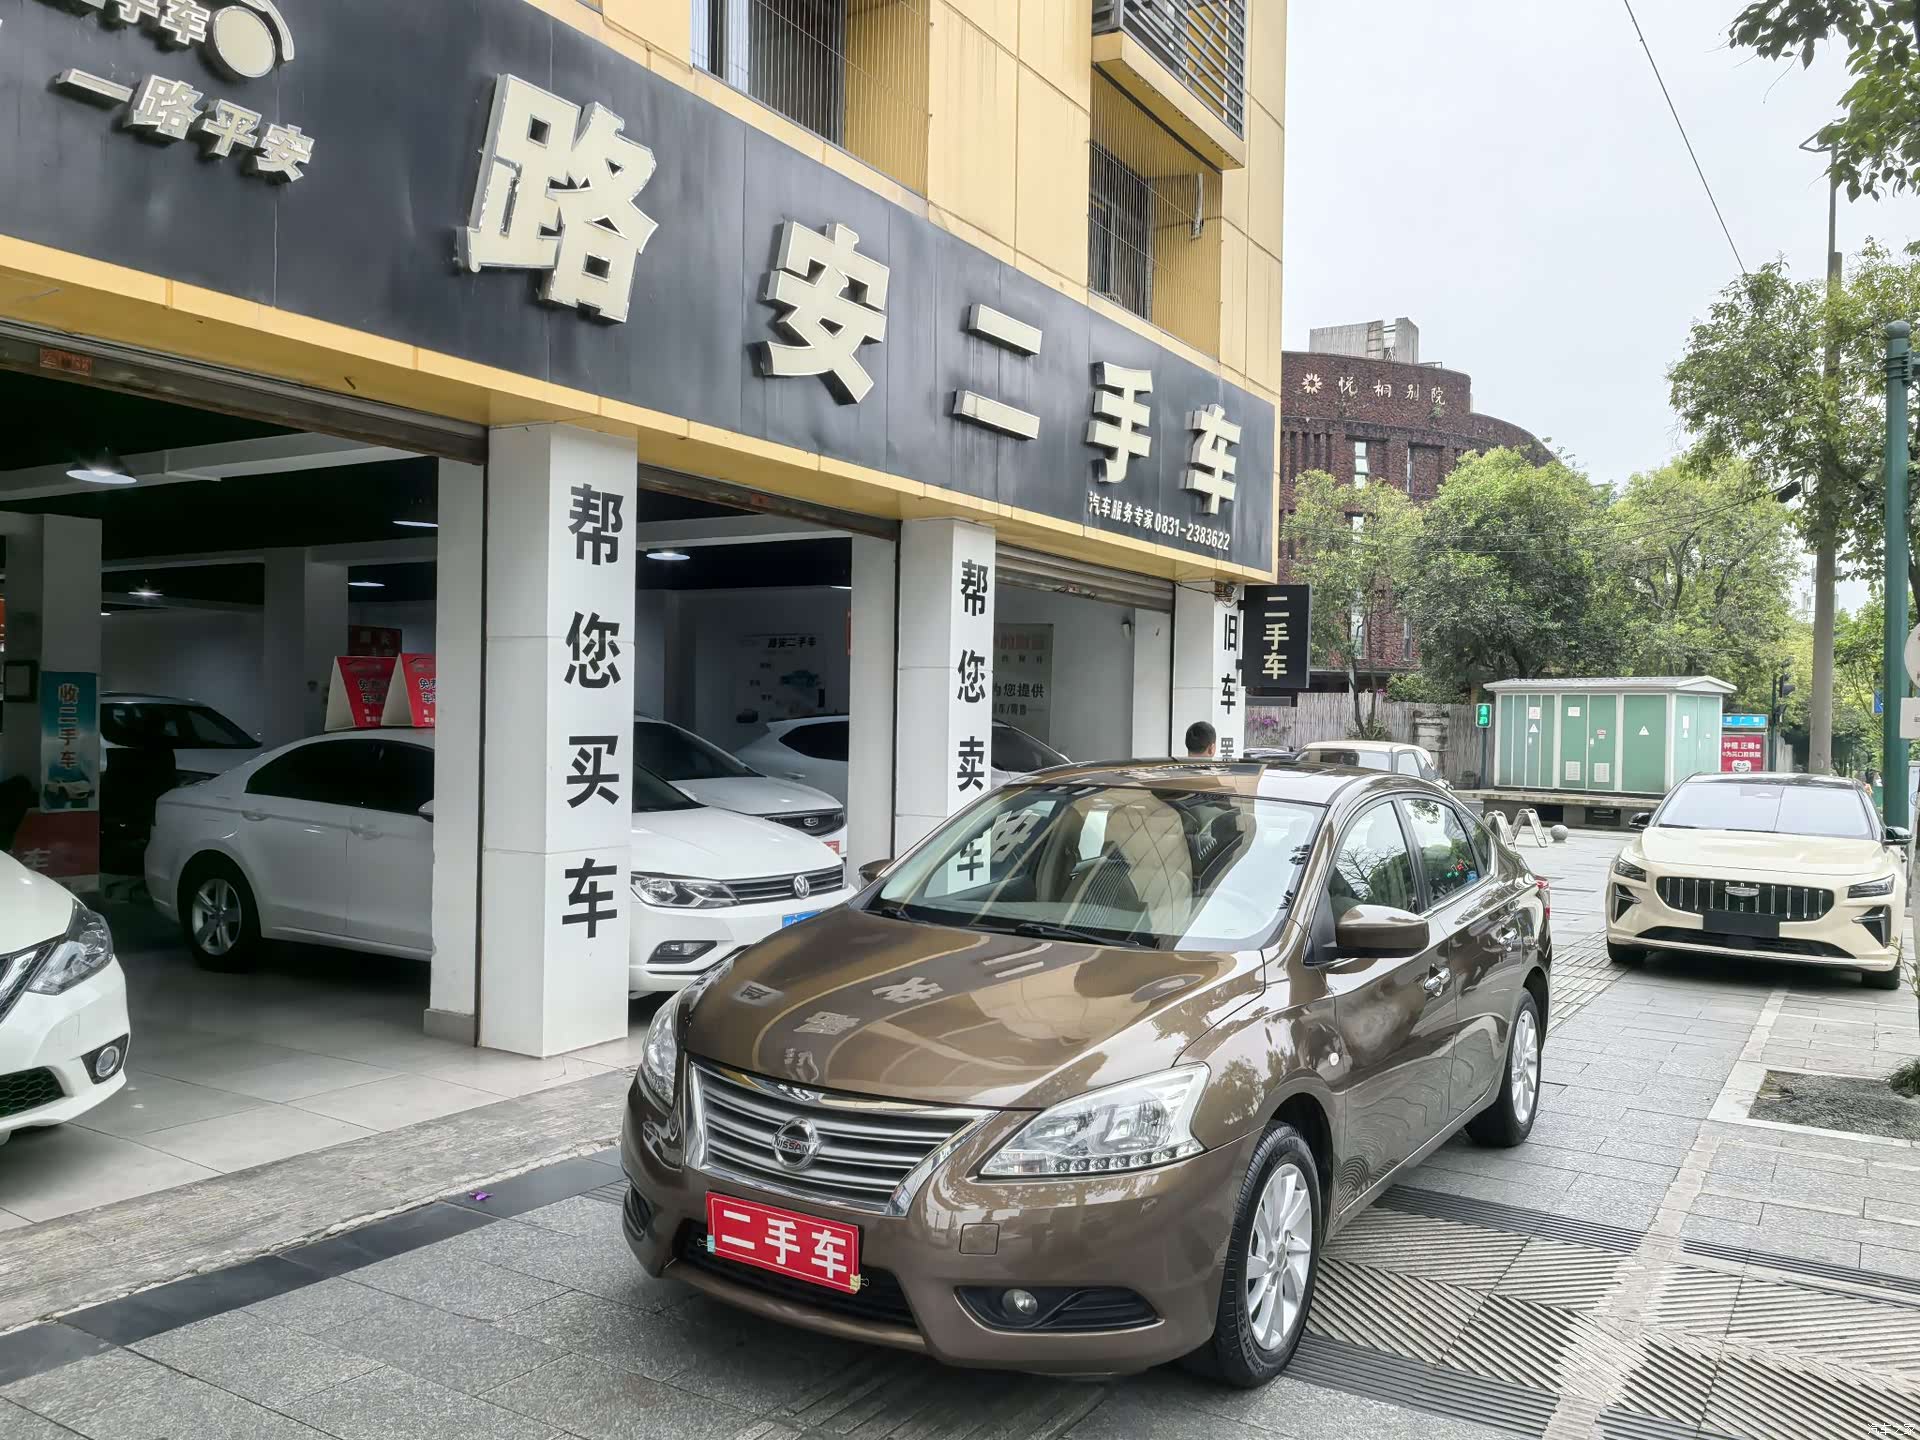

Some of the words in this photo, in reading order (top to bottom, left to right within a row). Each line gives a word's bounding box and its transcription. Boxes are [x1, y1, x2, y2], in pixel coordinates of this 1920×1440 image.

[57, 67, 316, 183] 一路平安
[459, 73, 1243, 515] 路安二手车
[1338, 376, 1446, 406] 悦桐别院
[1088, 490, 1154, 530] 汽车服务专家
[1154, 512, 1231, 551] 0831-2383622
[1262, 595, 1290, 680] 二手车
[562, 483, 624, 939] 帮您买车
[775, 1133, 811, 1153] NISSAN
[721, 1209, 848, 1280] 二手车
